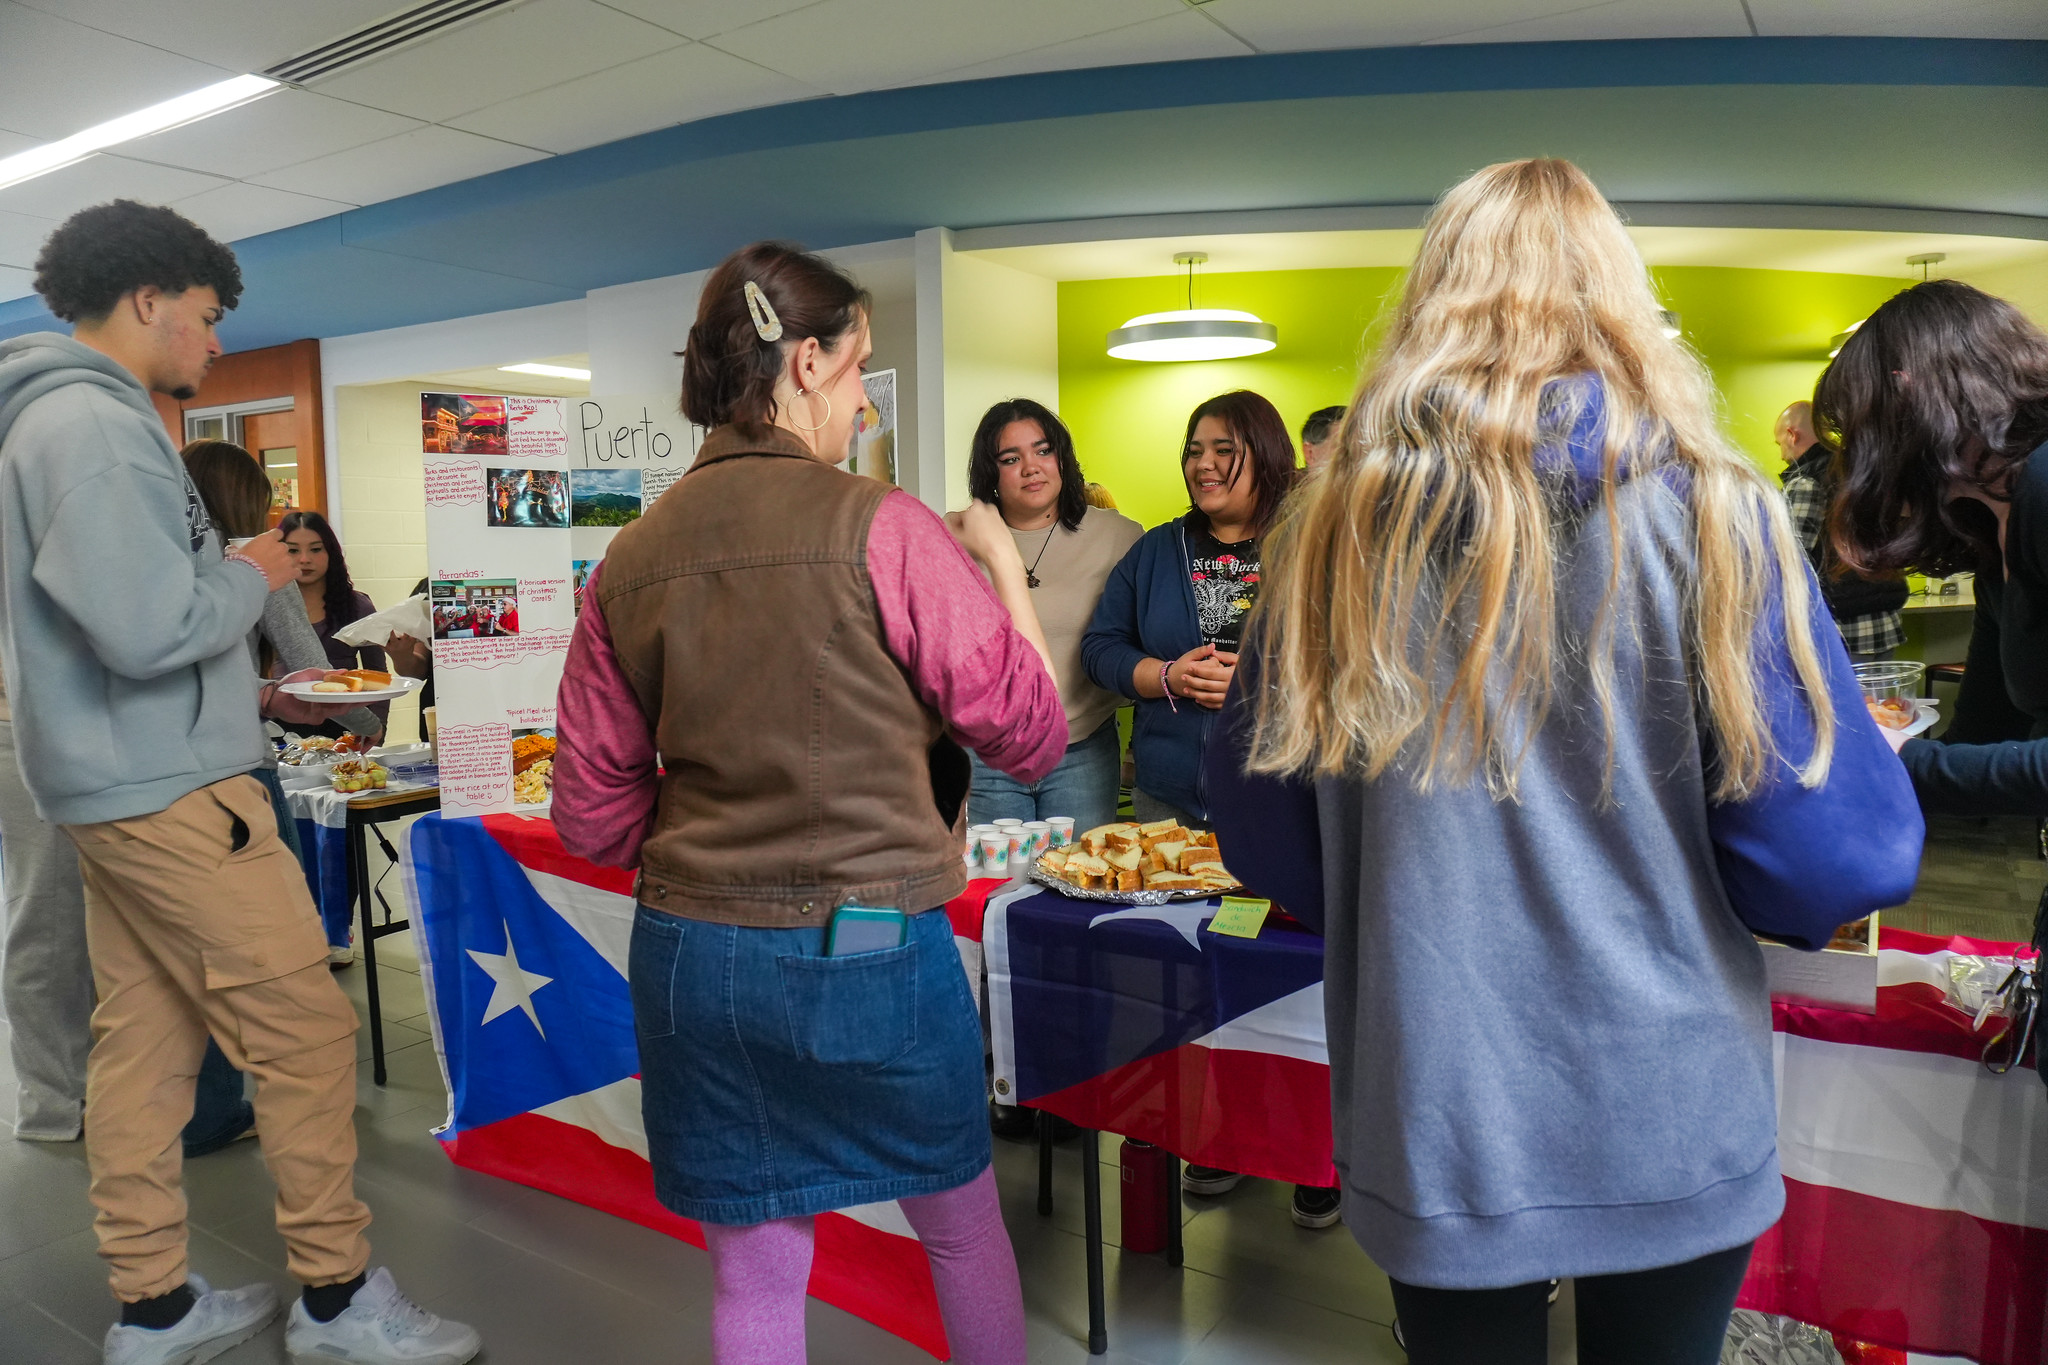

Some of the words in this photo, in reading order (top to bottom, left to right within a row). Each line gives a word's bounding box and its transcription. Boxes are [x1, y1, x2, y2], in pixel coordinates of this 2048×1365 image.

[580, 402, 671, 468] Puerto
[1193, 558, 1223, 572] New
[1228, 557, 1260, 575] York
[1224, 902, 1261, 913] Sandwich
